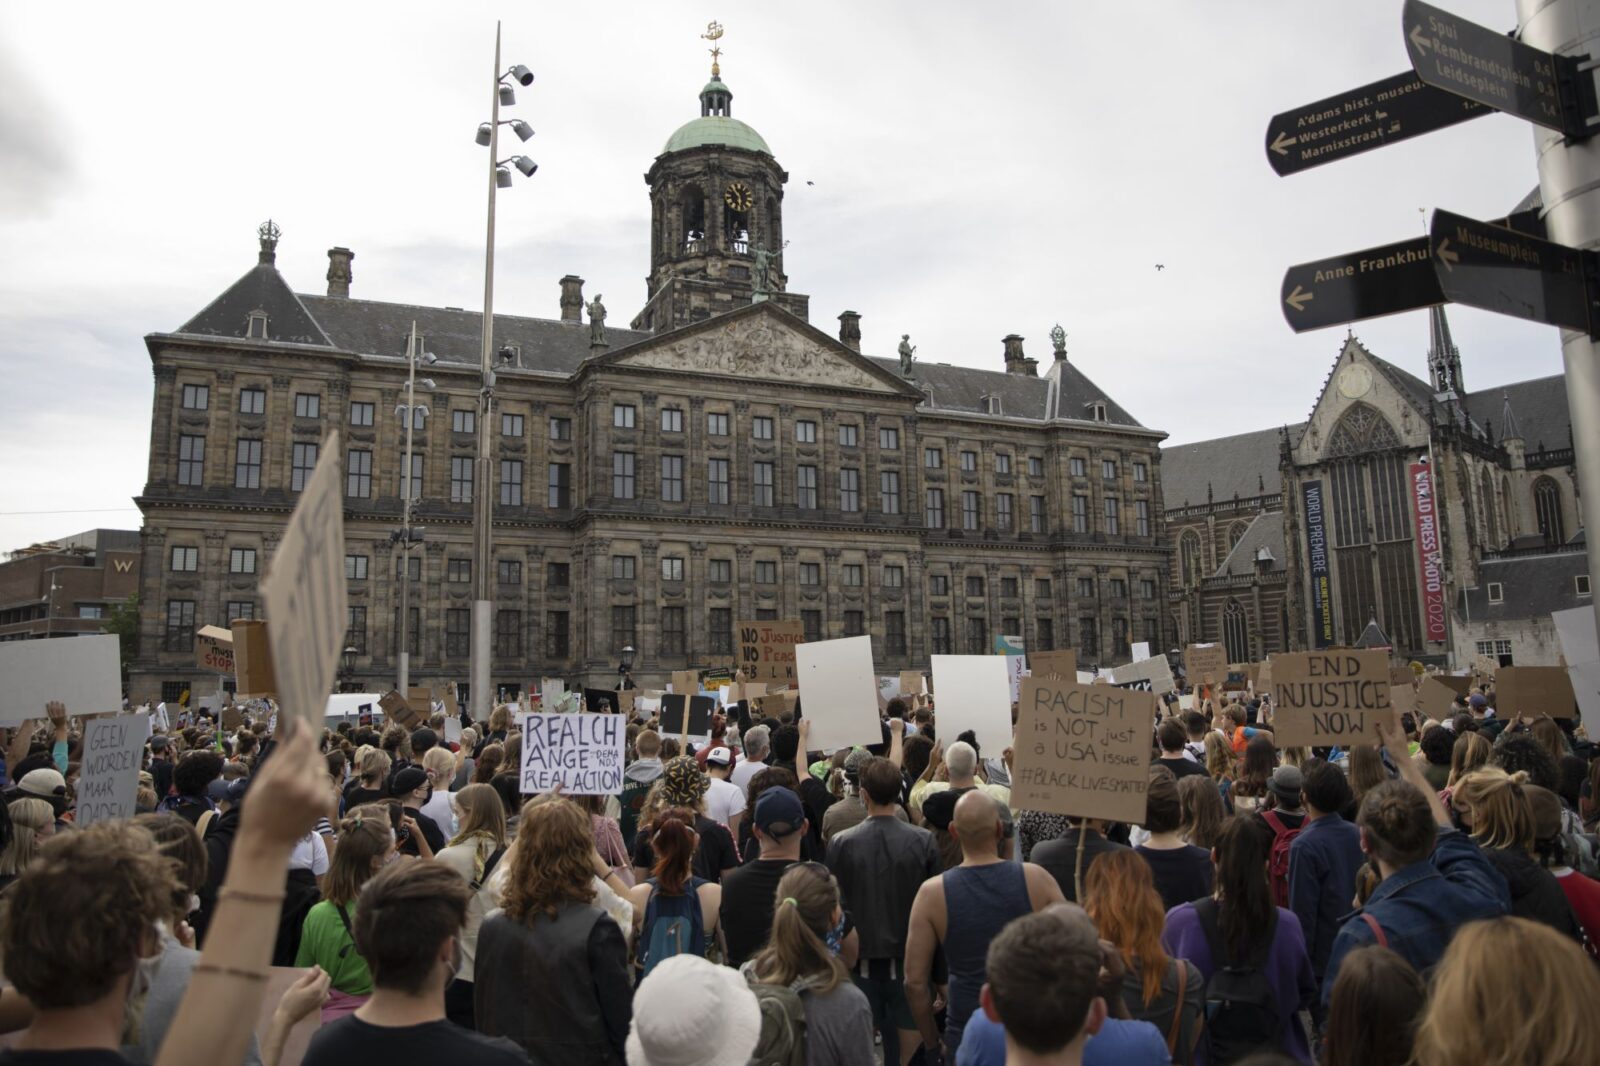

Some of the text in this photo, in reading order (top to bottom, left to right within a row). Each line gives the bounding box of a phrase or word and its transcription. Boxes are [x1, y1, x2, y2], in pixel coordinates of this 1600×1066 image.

[1429, 16, 1458, 39] Spui
[1432, 38, 1531, 88] Rembrandtplein
[1436, 59, 1508, 99] Leidseplein
[1297, 106, 1341, 128] A'dams
[1344, 97, 1374, 113] hist.
[1299, 111, 1372, 144] Westerkerk
[1301, 127, 1384, 161] Marnixstraat
[1456, 226, 1540, 265] Museumplein
[1314, 263, 1354, 284] Anne
[1306, 487, 1321, 523] WORLD
[1419, 514, 1437, 550] PRESS
[1309, 525, 1327, 573] PREMIERE
[114, 559, 133, 572] W
[1427, 595, 1446, 633] 2020
[741, 627, 758, 644] NO
[743, 646, 796, 662] NO PEAC
[1308, 656, 1361, 676] END
[1035, 687, 1124, 719] RACISM
[1276, 680, 1391, 710] INJUSTICE
[1035, 718, 1136, 746] is NOT just
[1312, 711, 1364, 735] NOW
[91, 724, 128, 751] GEEN
[86, 750, 139, 776] WOORDEN
[526, 743, 589, 770] ANGE
[1034, 740, 1140, 766] a USA issue
[84, 777, 114, 797] MAAR
